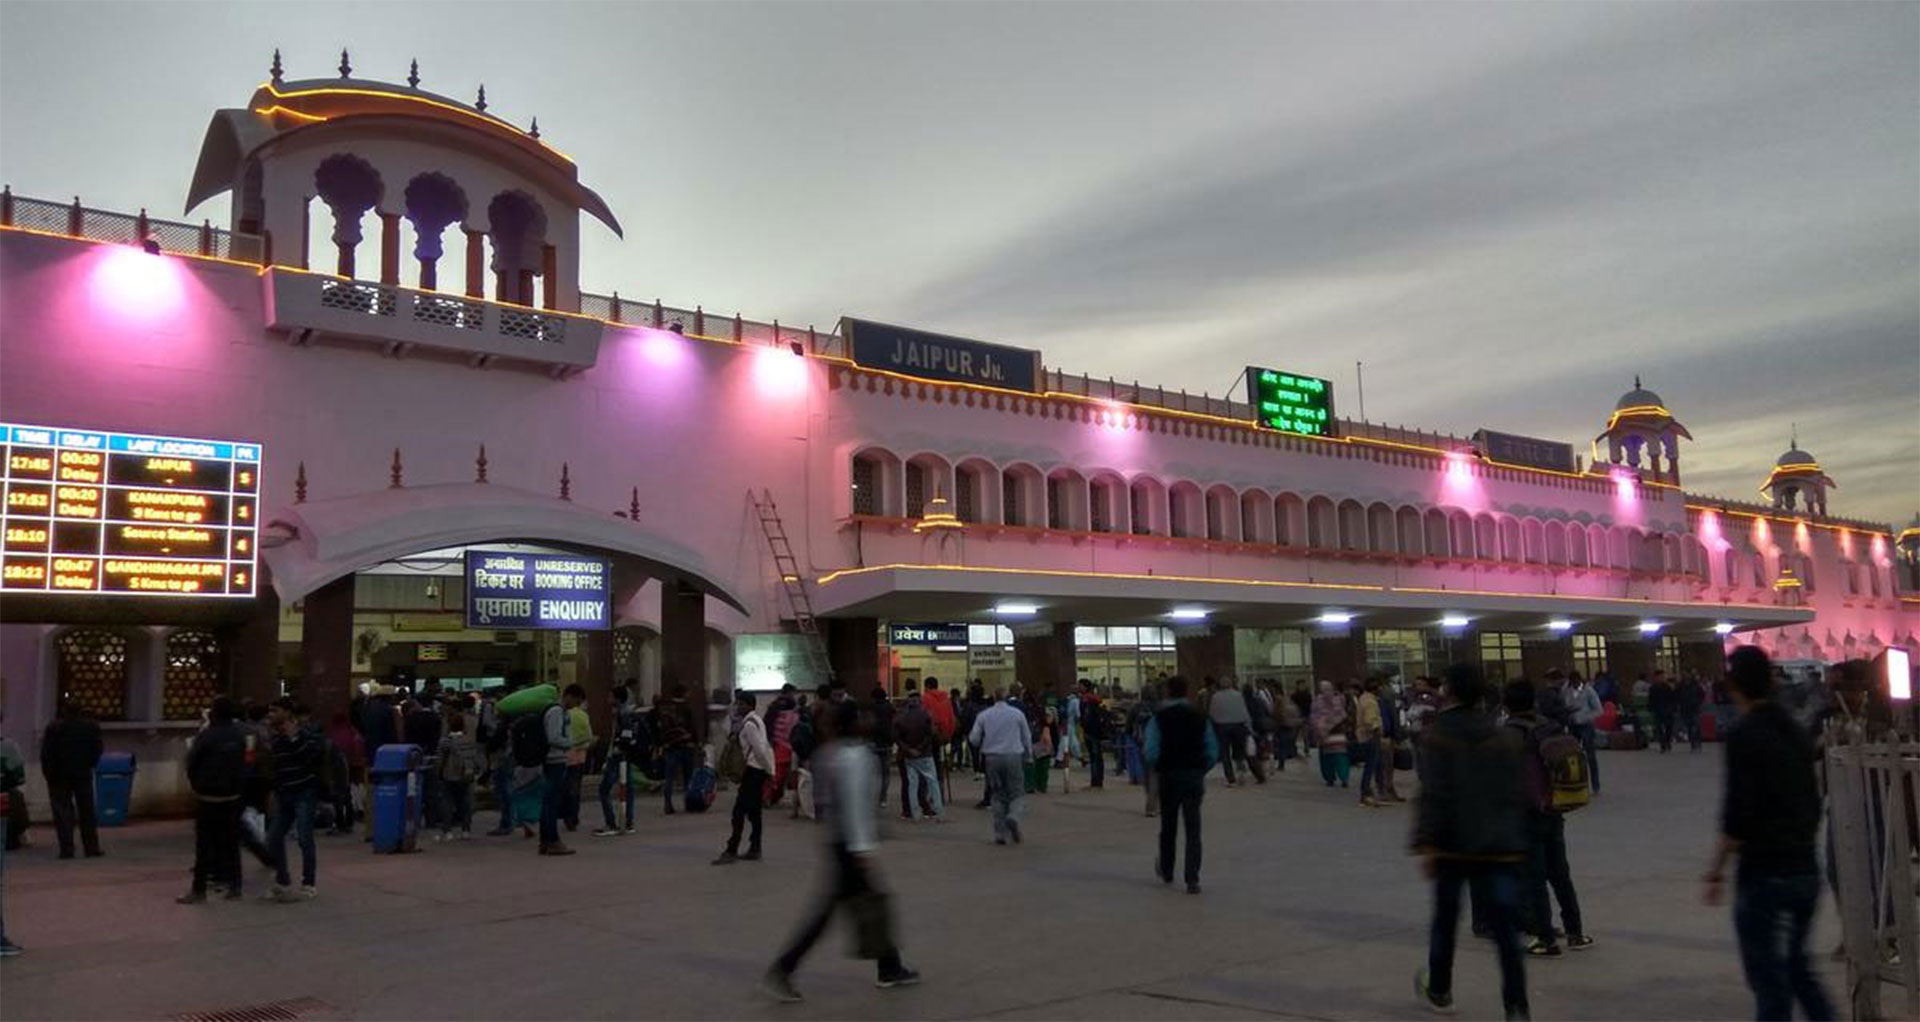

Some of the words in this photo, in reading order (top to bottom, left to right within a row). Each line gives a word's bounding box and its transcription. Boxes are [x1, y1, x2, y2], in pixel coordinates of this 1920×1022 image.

[891, 338, 974, 377] JAIPUR
[17, 430, 50, 444] TIME
[62, 434, 100, 448] DELAY
[127, 439, 156, 453] LAST
[158, 442, 216, 457] LOCATION
[61, 452, 100, 466] 00:20
[146, 458, 193, 472] JAIPUR
[61, 467, 99, 482] Delay
[128, 491, 206, 507] KANAKPURA
[59, 503, 97, 518] Delay
[171, 509, 184, 520] to
[185, 511, 202, 523] go
[122, 526, 167, 540] Source
[168, 527, 210, 541] Station
[535, 560, 603, 573] UNRESERVED
[54, 574, 93, 590] Delay
[168, 579, 181, 590] to
[182, 581, 199, 592] go
[475, 569, 508, 588] टिकट
[509, 573, 525, 589] घर
[535, 573, 573, 588] BOOKING
[574, 575, 603, 590] OFFICE
[475, 597, 533, 624] पूछताछ
[540, 600, 604, 621] ENQUIRY
[895, 627, 924, 641] प्रवेश
[927, 630, 967, 641] ENTRANCE
